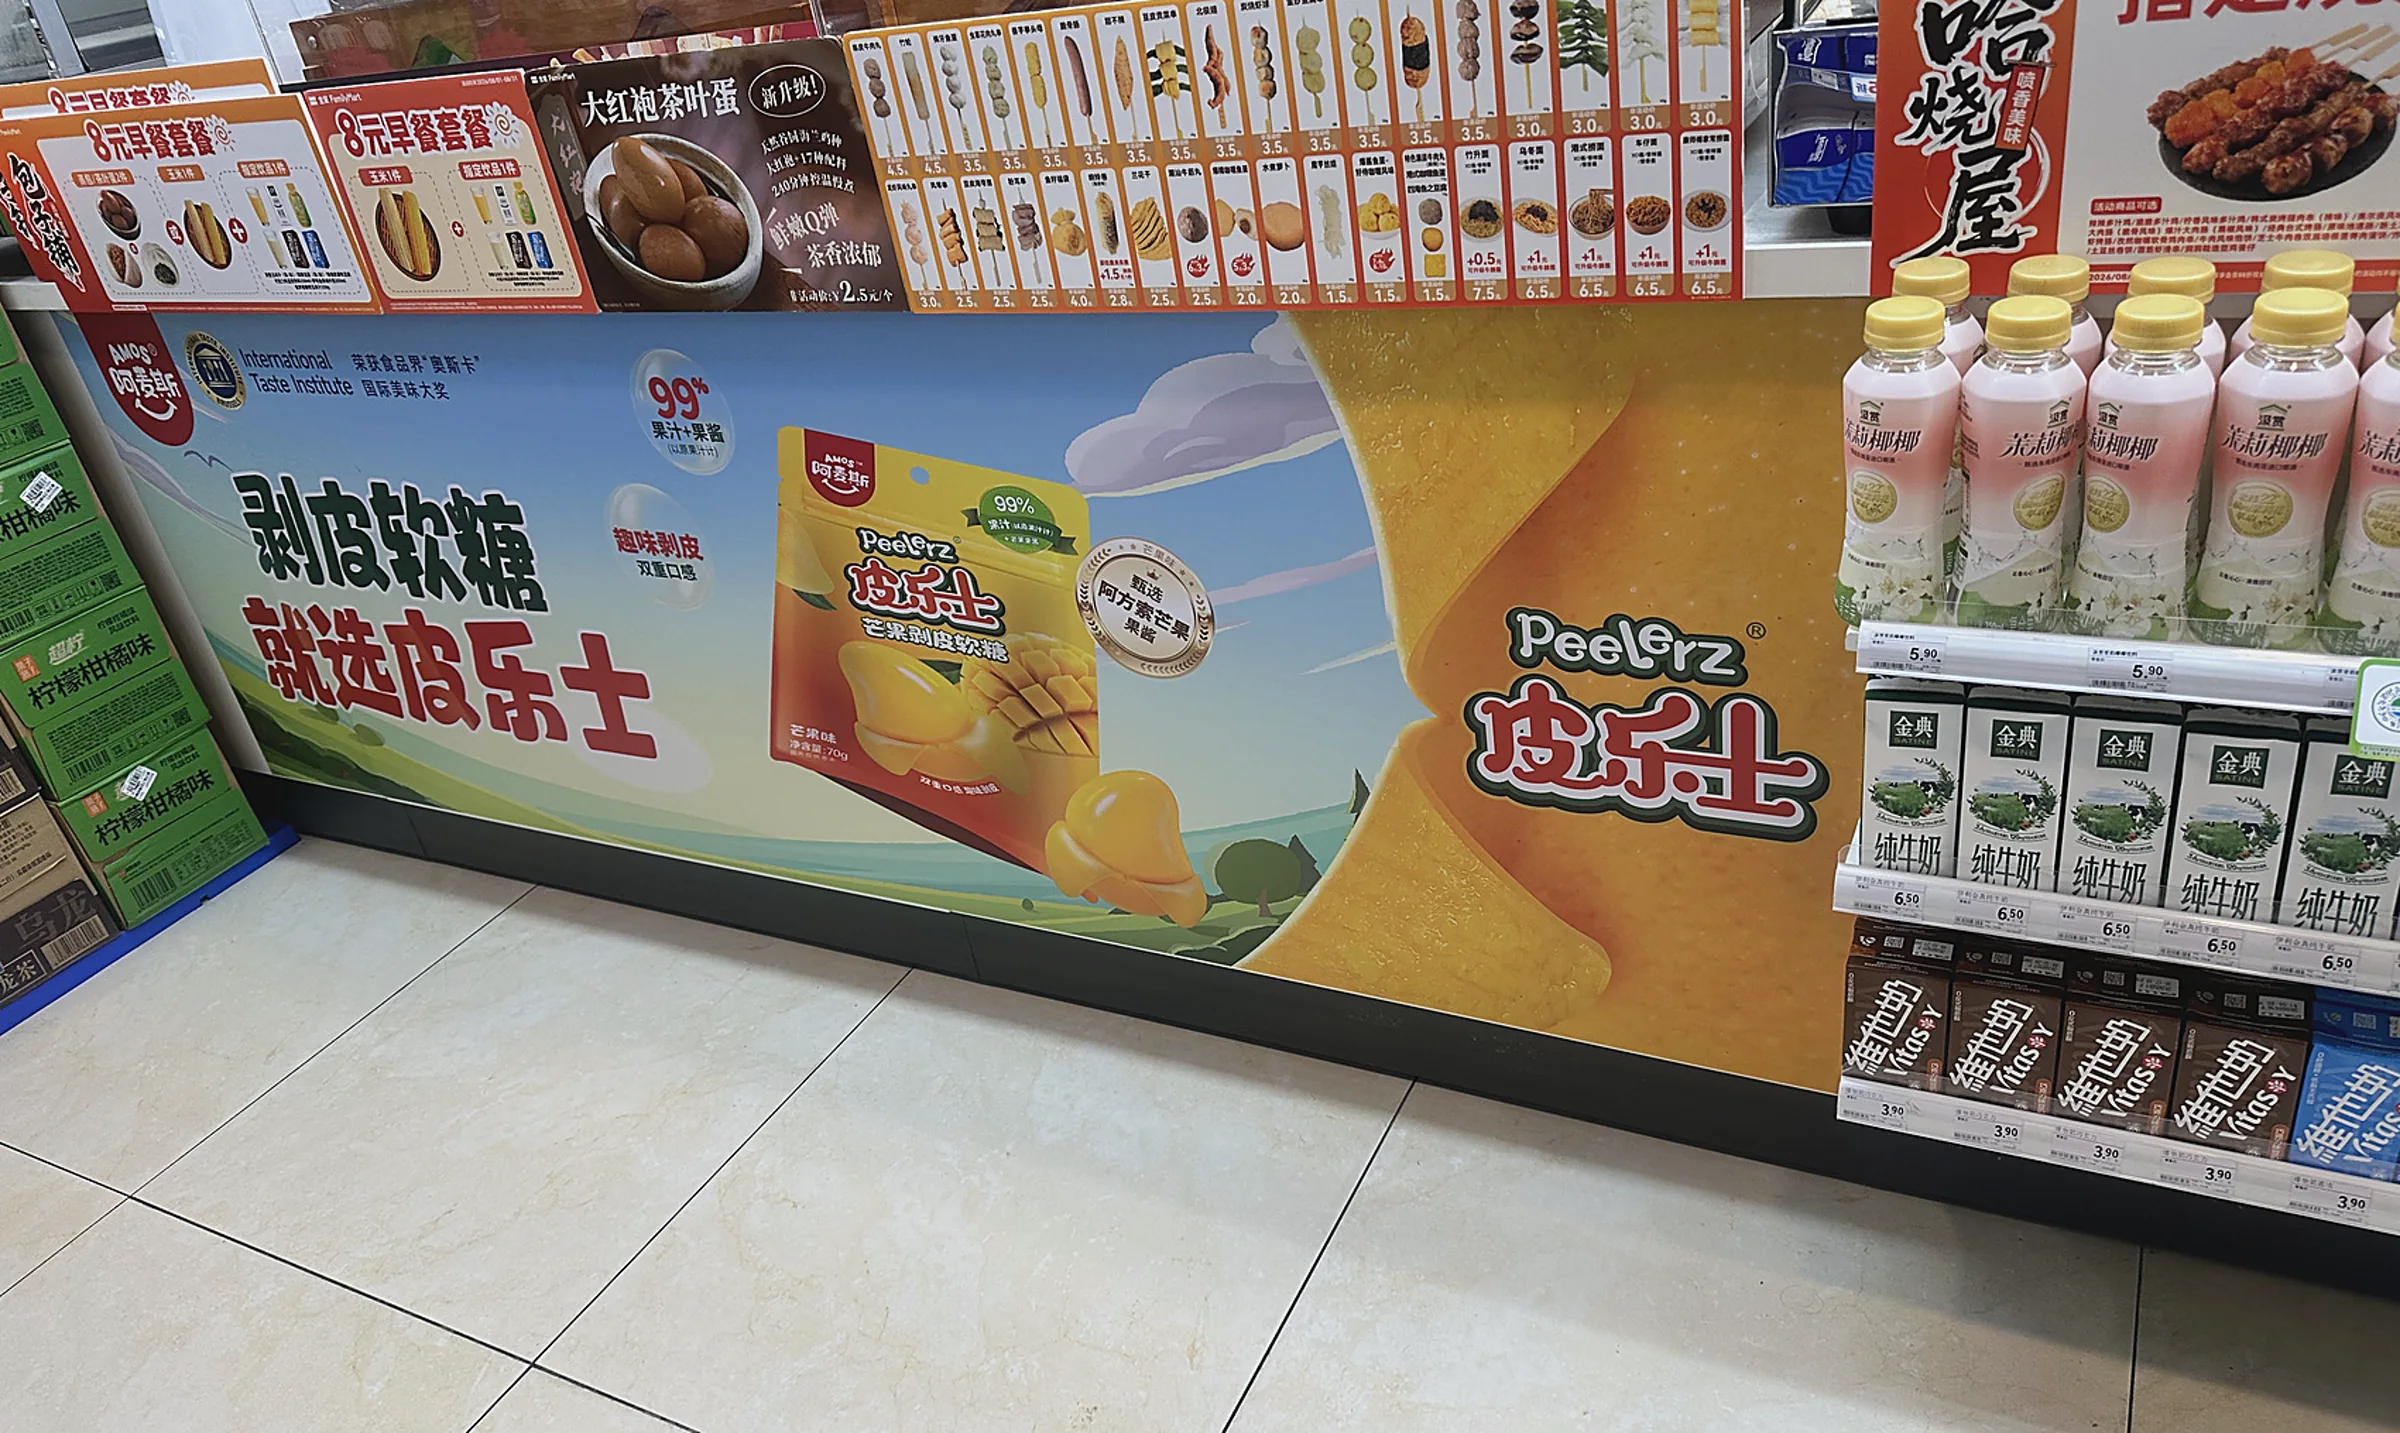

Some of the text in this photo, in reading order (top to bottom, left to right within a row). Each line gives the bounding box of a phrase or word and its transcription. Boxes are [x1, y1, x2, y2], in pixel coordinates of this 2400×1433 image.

[581, 77, 741, 128] 大红袍茶叶蛋
[2004, 70, 2037, 147] 喷香美味
[86, 118, 215, 162] 8元早餐套餐
[336, 106, 493, 156] 8元早餐套餐
[368, 169, 403, 184] 玉米1件
[462, 161, 518, 179] 指定饮品1件
[2093, 200, 2158, 213] 活动商品可选
[769, 202, 840, 250] 鲜嫩Q弹
[806, 241, 882, 269] 茶香浓郁
[109, 342, 151, 366] AMOS
[239, 348, 332, 371] International
[107, 364, 181, 399] 阿麦斯
[250, 373, 353, 397] Taste Institute
[362, 380, 451, 401] 国际美味大奖
[648, 376, 710, 420] 99%
[651, 421, 725, 444] 果汁+果酱
[2221, 424, 2329, 460] 茉莉椰椰
[825, 453, 855, 468] AMOS
[811, 461, 870, 489] 阿麦斯
[993, 495, 1035, 514] 99%
[233, 473, 548, 613] 剥皮软糖
[612, 527, 704, 561] 趣味剥皮
[861, 529, 955, 562] Peelerz
[636, 560, 698, 581] 双重口感
[850, 558, 1002, 630] 皮乐士
[1129, 573, 1164, 604] 甄选
[1098, 579, 1191, 642] 阿方索芒果
[861, 617, 1009, 663] 芒果剥皮软糖
[1123, 617, 1158, 645] 果酱
[1514, 611, 1738, 677] Peelerz
[1909, 647, 1938, 662] 5.90
[28, 633, 156, 711] 柠檬柑橘味
[242, 598, 658, 760] 就选皮乐士
[2132, 663, 2164, 680] 5.90
[790, 724, 837, 745] 芒果味
[1893, 715, 1935, 739] 金典
[1996, 724, 2038, 749] 金典
[1477, 680, 1813, 824] 皮乐士
[2102, 734, 2147, 760] 金典
[2216, 750, 2263, 777] 金典
[2338, 760, 2388, 786] 金典
[95, 768, 216, 847] 柠檬柑橘味
[1874, 832, 1942, 877] 纯牛奶
[1971, 843, 2041, 891] 纯牛奶
[2073, 856, 2147, 905] 纯牛奶
[1893, 891, 1920, 907] 6.50
[2181, 874, 2260, 921] 纯牛奶
[14, 887, 99, 950] 乌龙
[1997, 906, 2024, 922] 6.50
[2297, 887, 2381, 938] 纯牛奶
[2103, 921, 2130, 938] 6.50
[2207, 938, 2237, 954] 6.50
[2322, 955, 2353, 971] 6.50
[1881, 1103, 1904, 1117] 3.90
[1994, 1124, 2018, 1139] 3.90
[2093, 1145, 2119, 1161] 3.90
[2204, 1167, 2232, 1182] 3.90
[2337, 1195, 2366, 1211] 3.90
